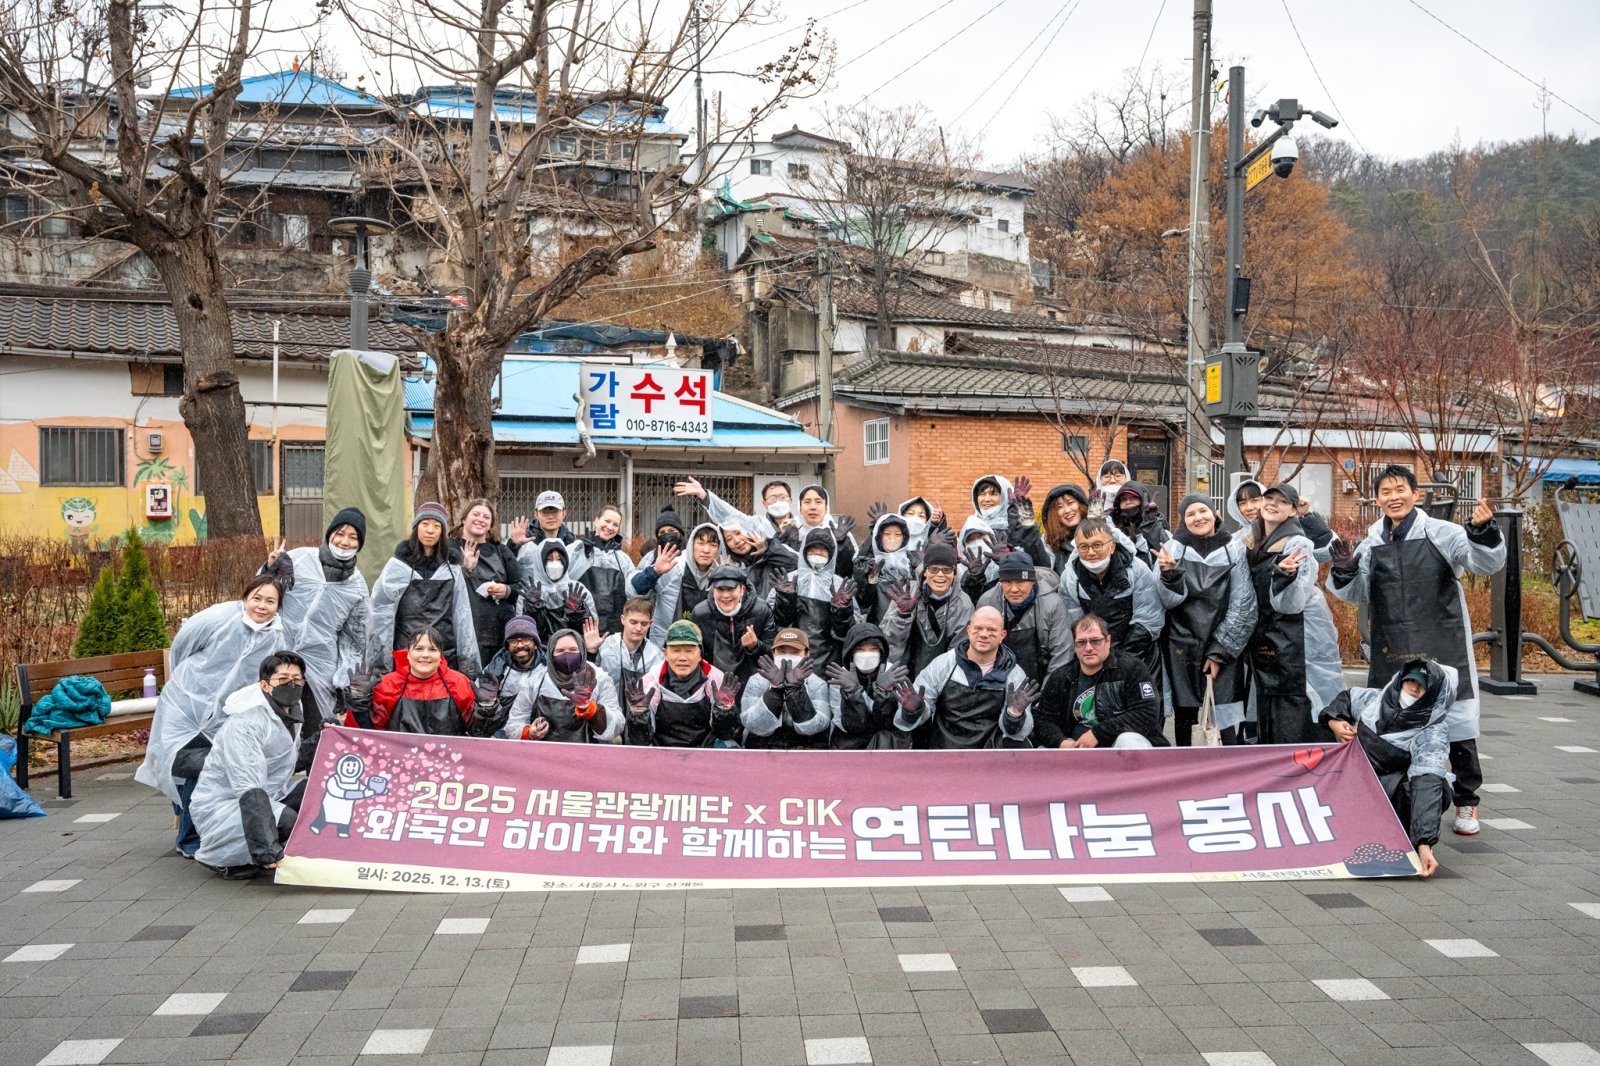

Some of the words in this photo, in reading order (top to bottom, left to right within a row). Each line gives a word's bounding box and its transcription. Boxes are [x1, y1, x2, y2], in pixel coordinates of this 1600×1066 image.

[630, 373, 706, 415] 수석
[626, 419, 708, 433] 010-8716-4343
[362, 809, 491, 848] 외국인
[502, 818, 668, 856] 하이커와
[681, 826, 847, 860] 함께하는
[851, 802, 1159, 862] 연탄나눔
[1178, 785, 1336, 854] 봉사
[410, 780, 517, 814] 2025
[524, 788, 734, 824] 서울관광재단
[779, 797, 842, 826] CIK
[357, 867, 388, 881] 일시:
[391, 870, 435, 885] 2025.
[439, 874, 459, 887] 12.
[464, 876, 510, 889] 13.(토)
